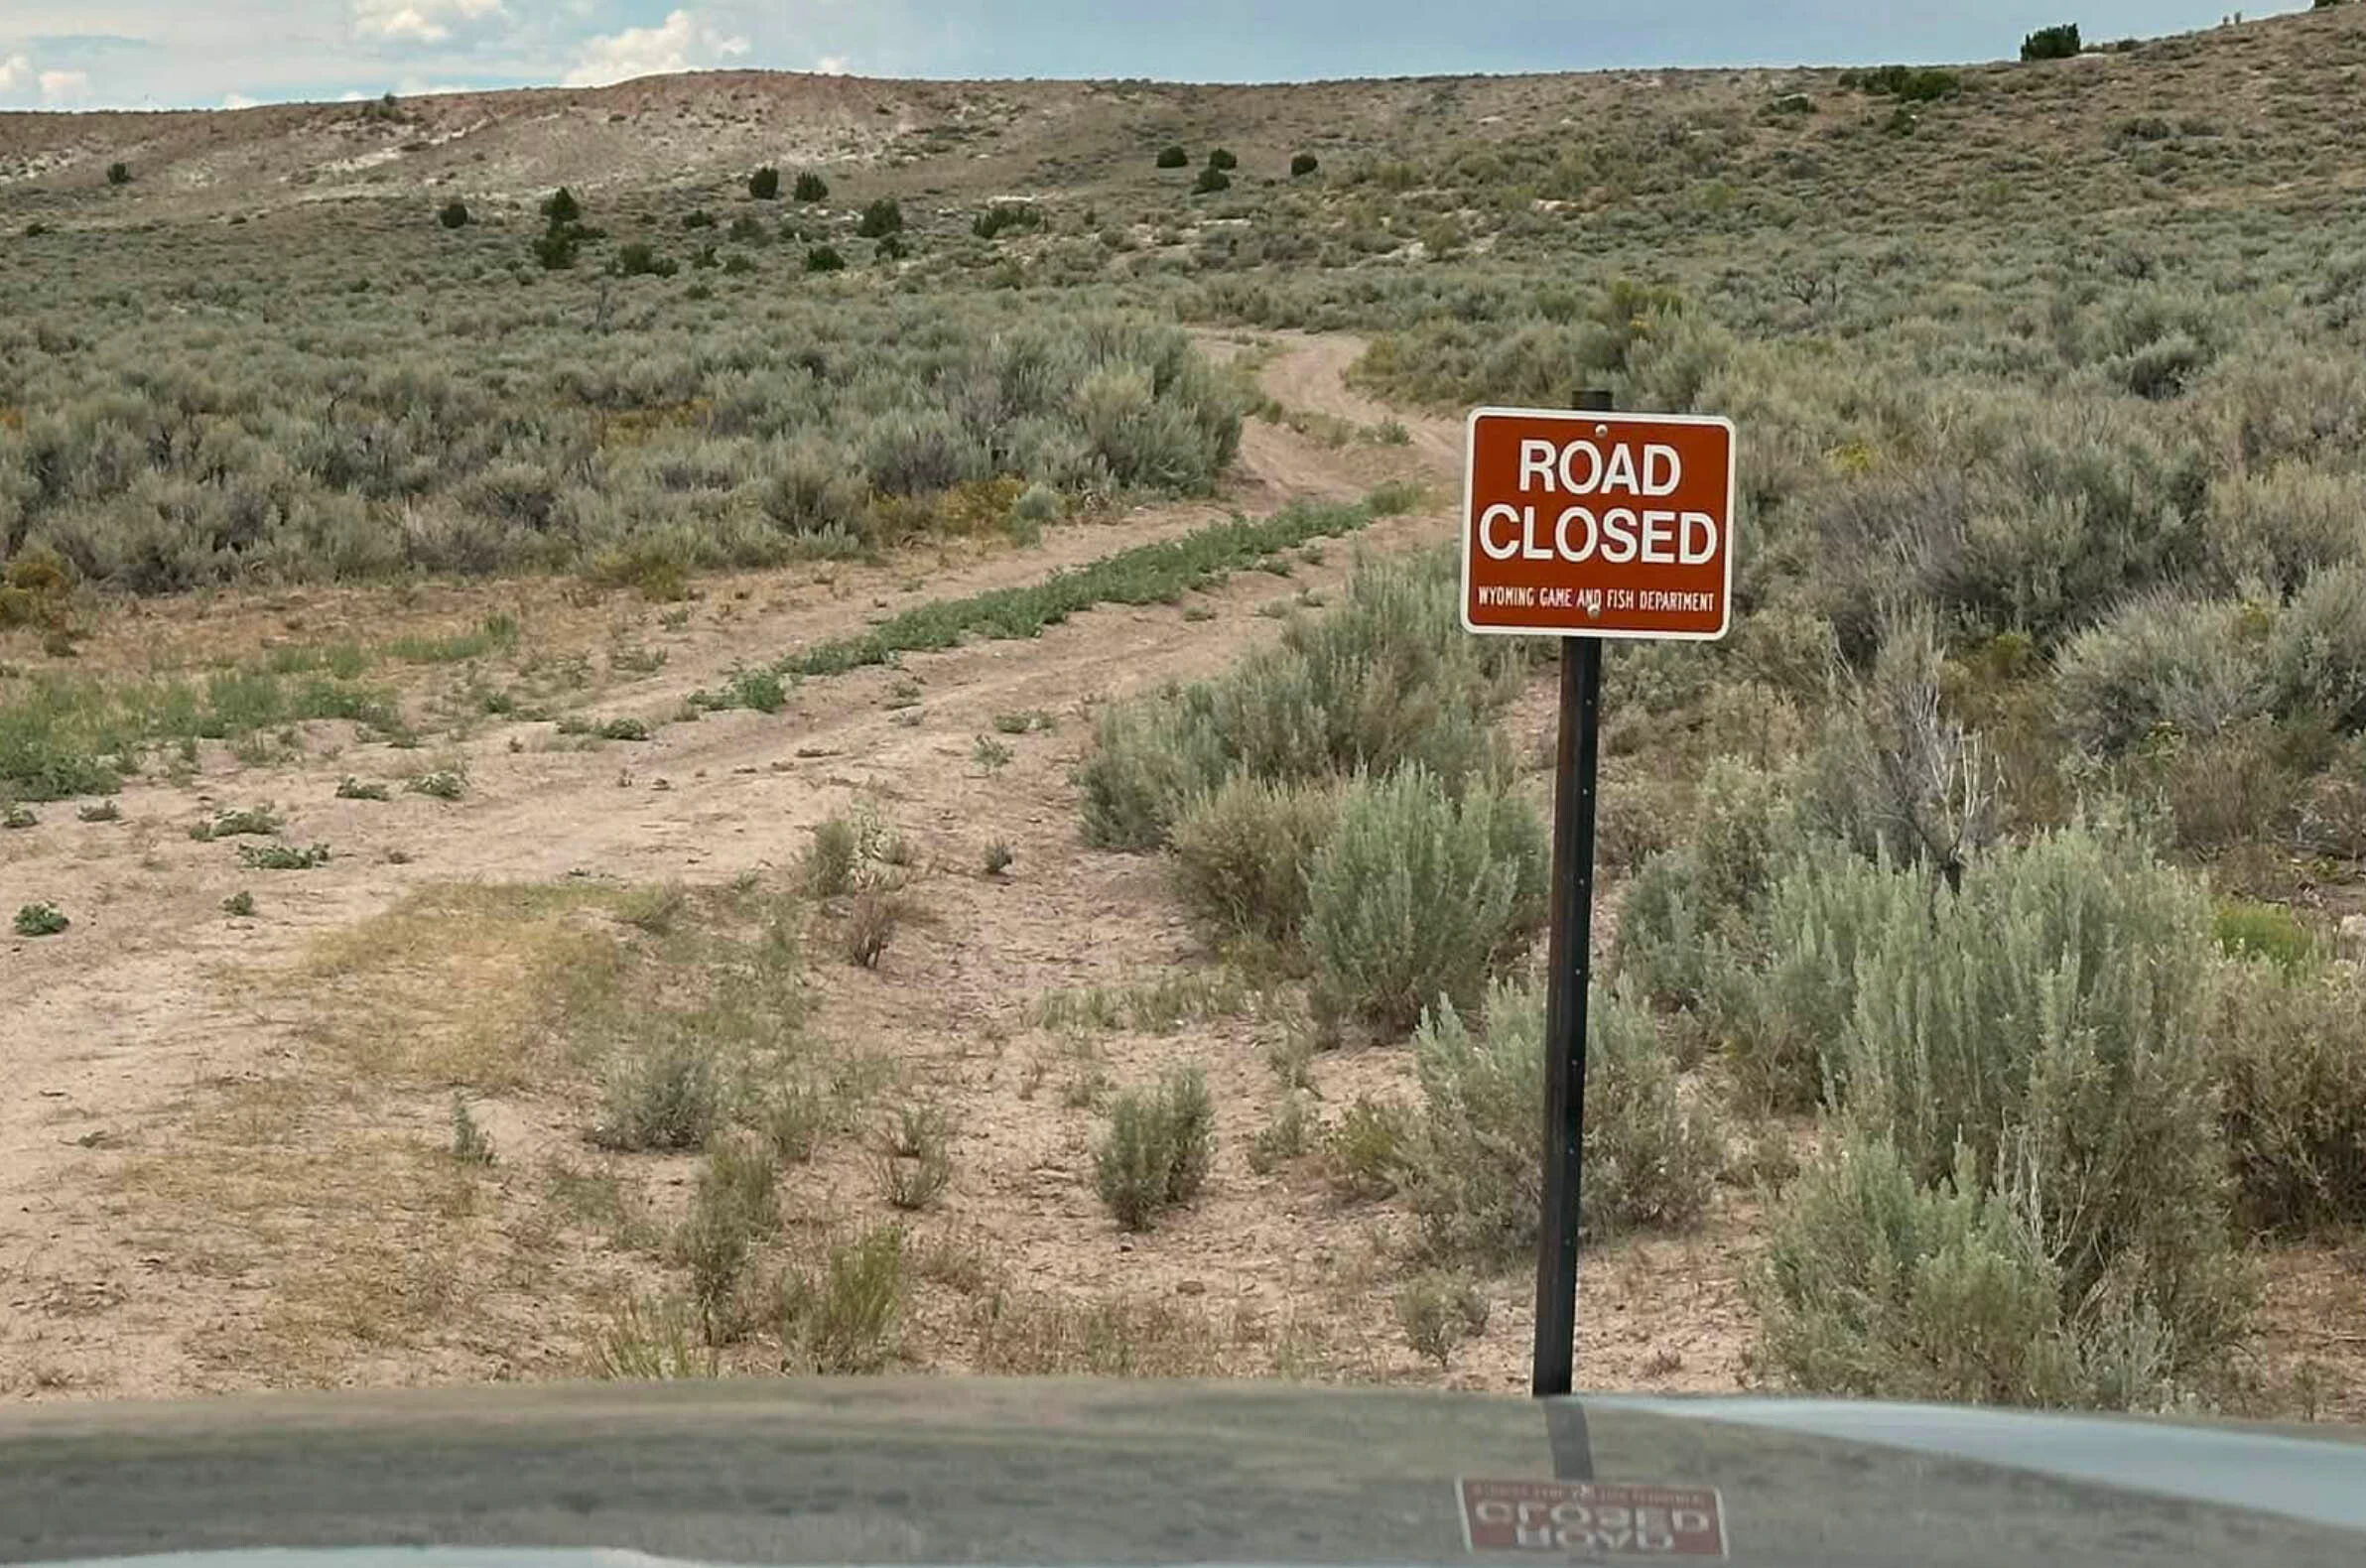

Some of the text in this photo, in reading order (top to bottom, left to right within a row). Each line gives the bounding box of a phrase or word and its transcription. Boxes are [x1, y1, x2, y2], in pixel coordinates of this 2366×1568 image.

[1519, 439, 1682, 496] ROAD
[1479, 503, 1718, 565] CLOSED
[1478, 586, 1715, 612] WYOMING GAME AND FISH DEPARTMENT
